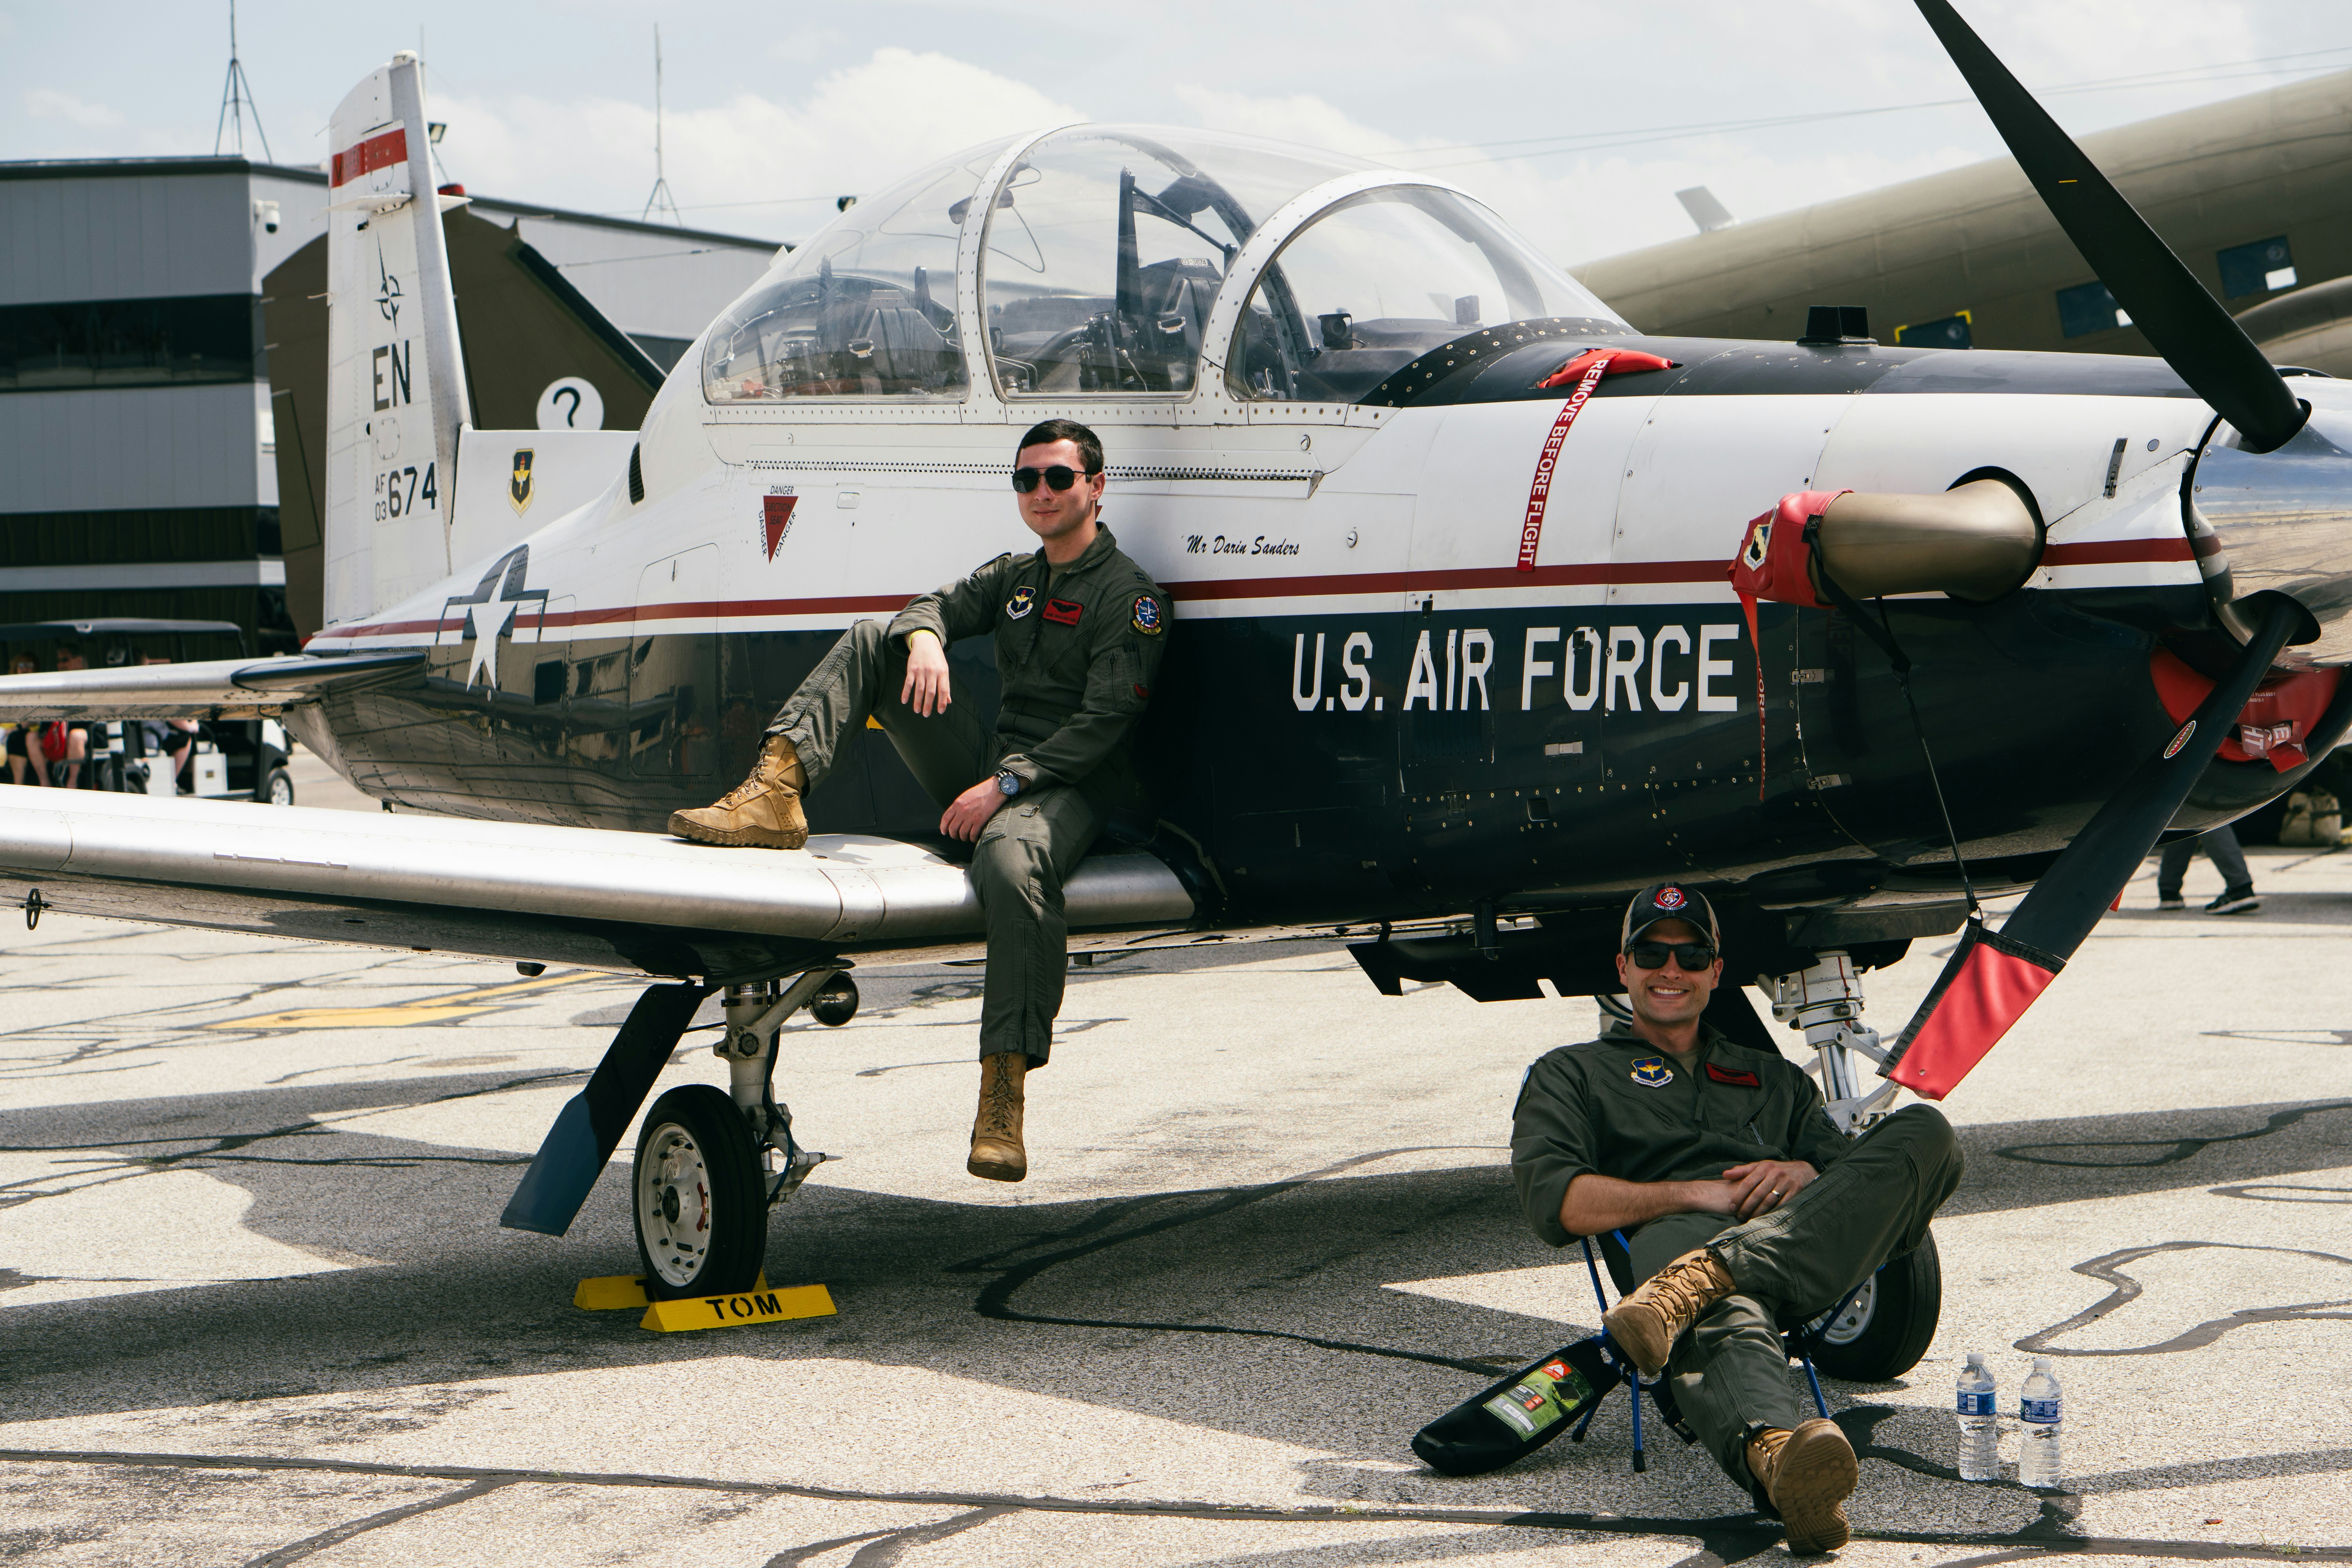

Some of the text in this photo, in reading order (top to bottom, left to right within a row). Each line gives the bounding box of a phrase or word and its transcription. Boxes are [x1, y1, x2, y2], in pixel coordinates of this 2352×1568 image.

[373, 339, 411, 412] EN
[1559, 359, 1610, 422] REMOVE
[1532, 426, 1568, 496] BEFORE
[375, 474, 385, 495] AF
[388, 462, 437, 518] 674
[765, 502, 792, 513] EJECTION
[770, 485, 794, 495] DANGER
[375, 501, 387, 522] 03
[759, 510, 768, 556] DANGER
[769, 515, 783, 525] SEAT
[775, 511, 797, 557] DANGER
[1520, 501, 1544, 565] FLIGHT
[1187, 534, 1300, 555] Mr Darin Sanders
[1292, 632, 1383, 711] U.S.
[1403, 628, 1494, 711] AIR
[1521, 624, 1739, 711] FORCE
[705, 1294, 783, 1320] TOM
